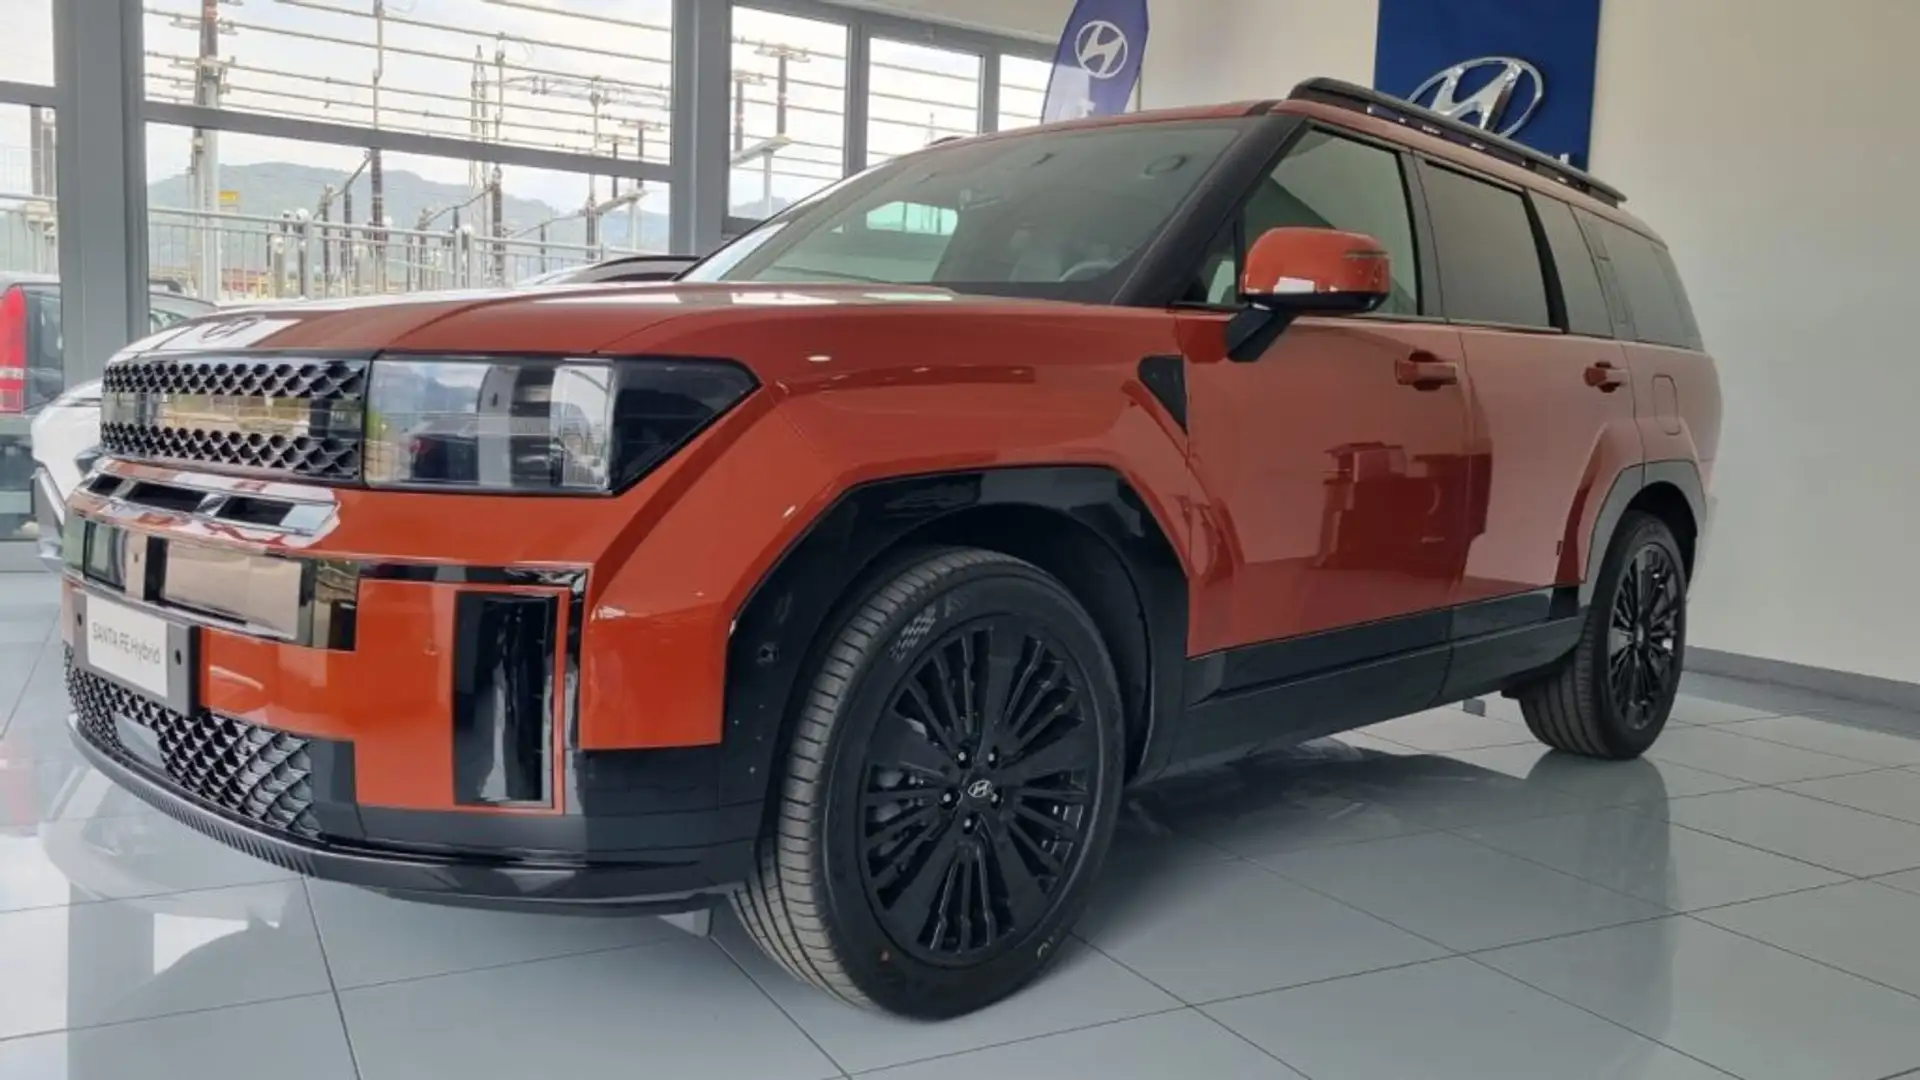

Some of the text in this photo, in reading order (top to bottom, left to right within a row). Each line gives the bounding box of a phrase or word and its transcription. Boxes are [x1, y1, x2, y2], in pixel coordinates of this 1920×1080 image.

[91, 621, 161, 665] SANTA FE Hybrid
